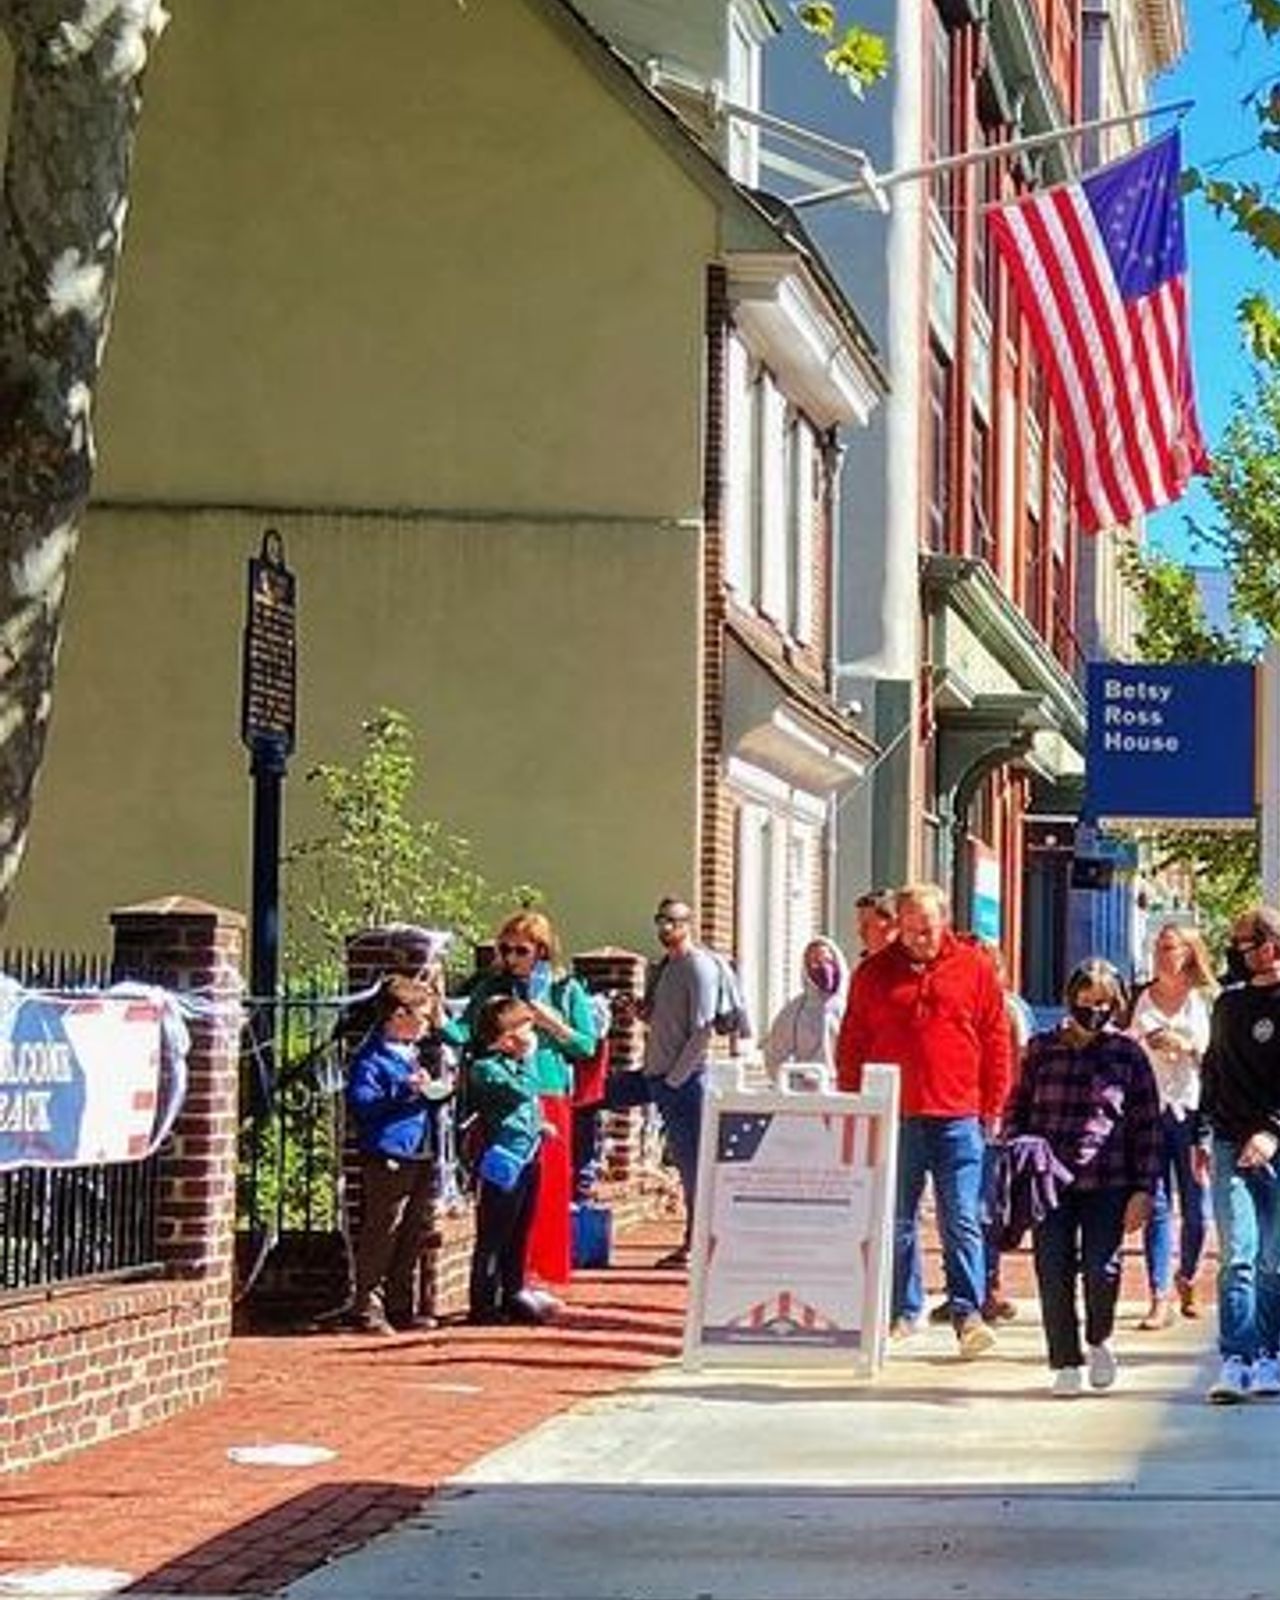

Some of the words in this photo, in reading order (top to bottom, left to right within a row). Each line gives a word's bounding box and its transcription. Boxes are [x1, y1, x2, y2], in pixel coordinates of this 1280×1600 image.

[1104, 679, 1172, 702] Betsy
[1104, 705, 1164, 726] Ross
[1104, 732, 1180, 752] House
